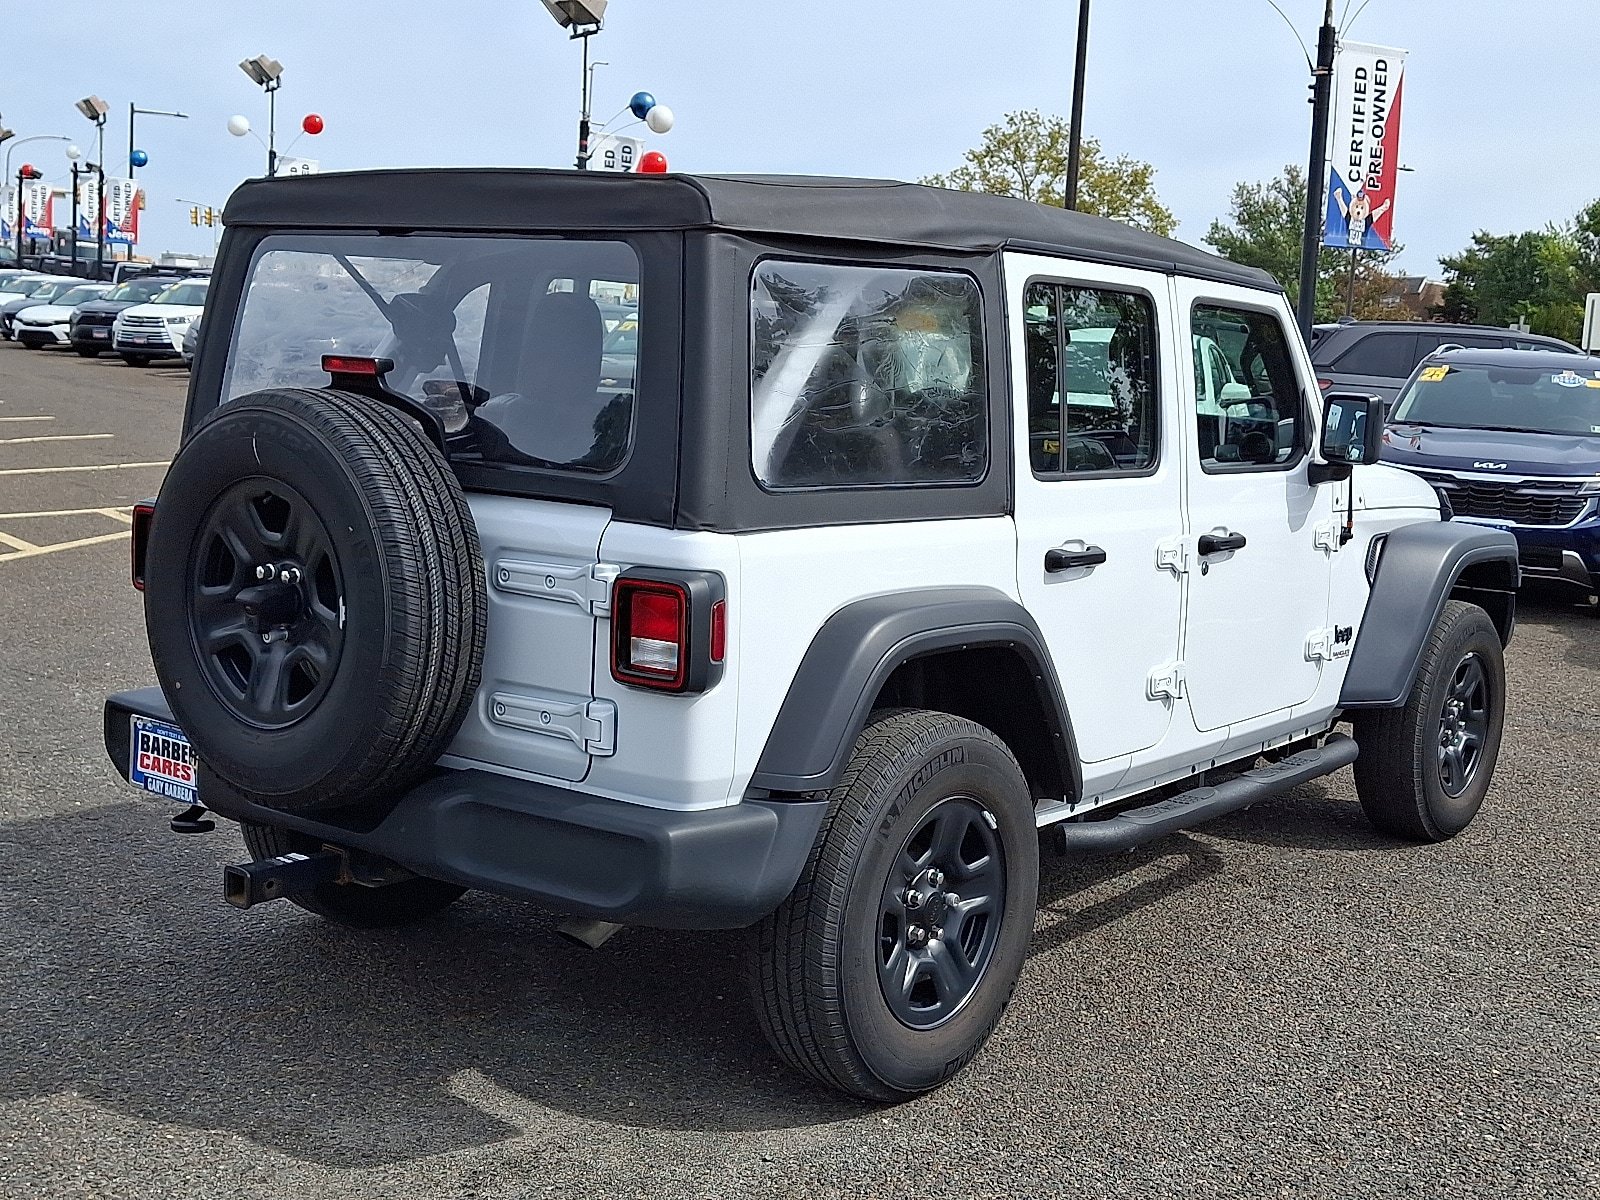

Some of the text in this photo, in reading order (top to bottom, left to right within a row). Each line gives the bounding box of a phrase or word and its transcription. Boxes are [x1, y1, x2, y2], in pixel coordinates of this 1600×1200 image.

[1348, 67, 1367, 183] CERTIFIED
[1368, 58, 1388, 189] PRE-OWNED
[108, 229, 135, 241] Jeep
[1473, 461, 1508, 470] KIA
[1334, 624, 1353, 647] Jeep
[141, 733, 196, 765] BARBER
[140, 753, 192, 781] CARES
[895, 745, 966, 813] MICHELIN
[147, 778, 193, 803] GARY BARBERA
